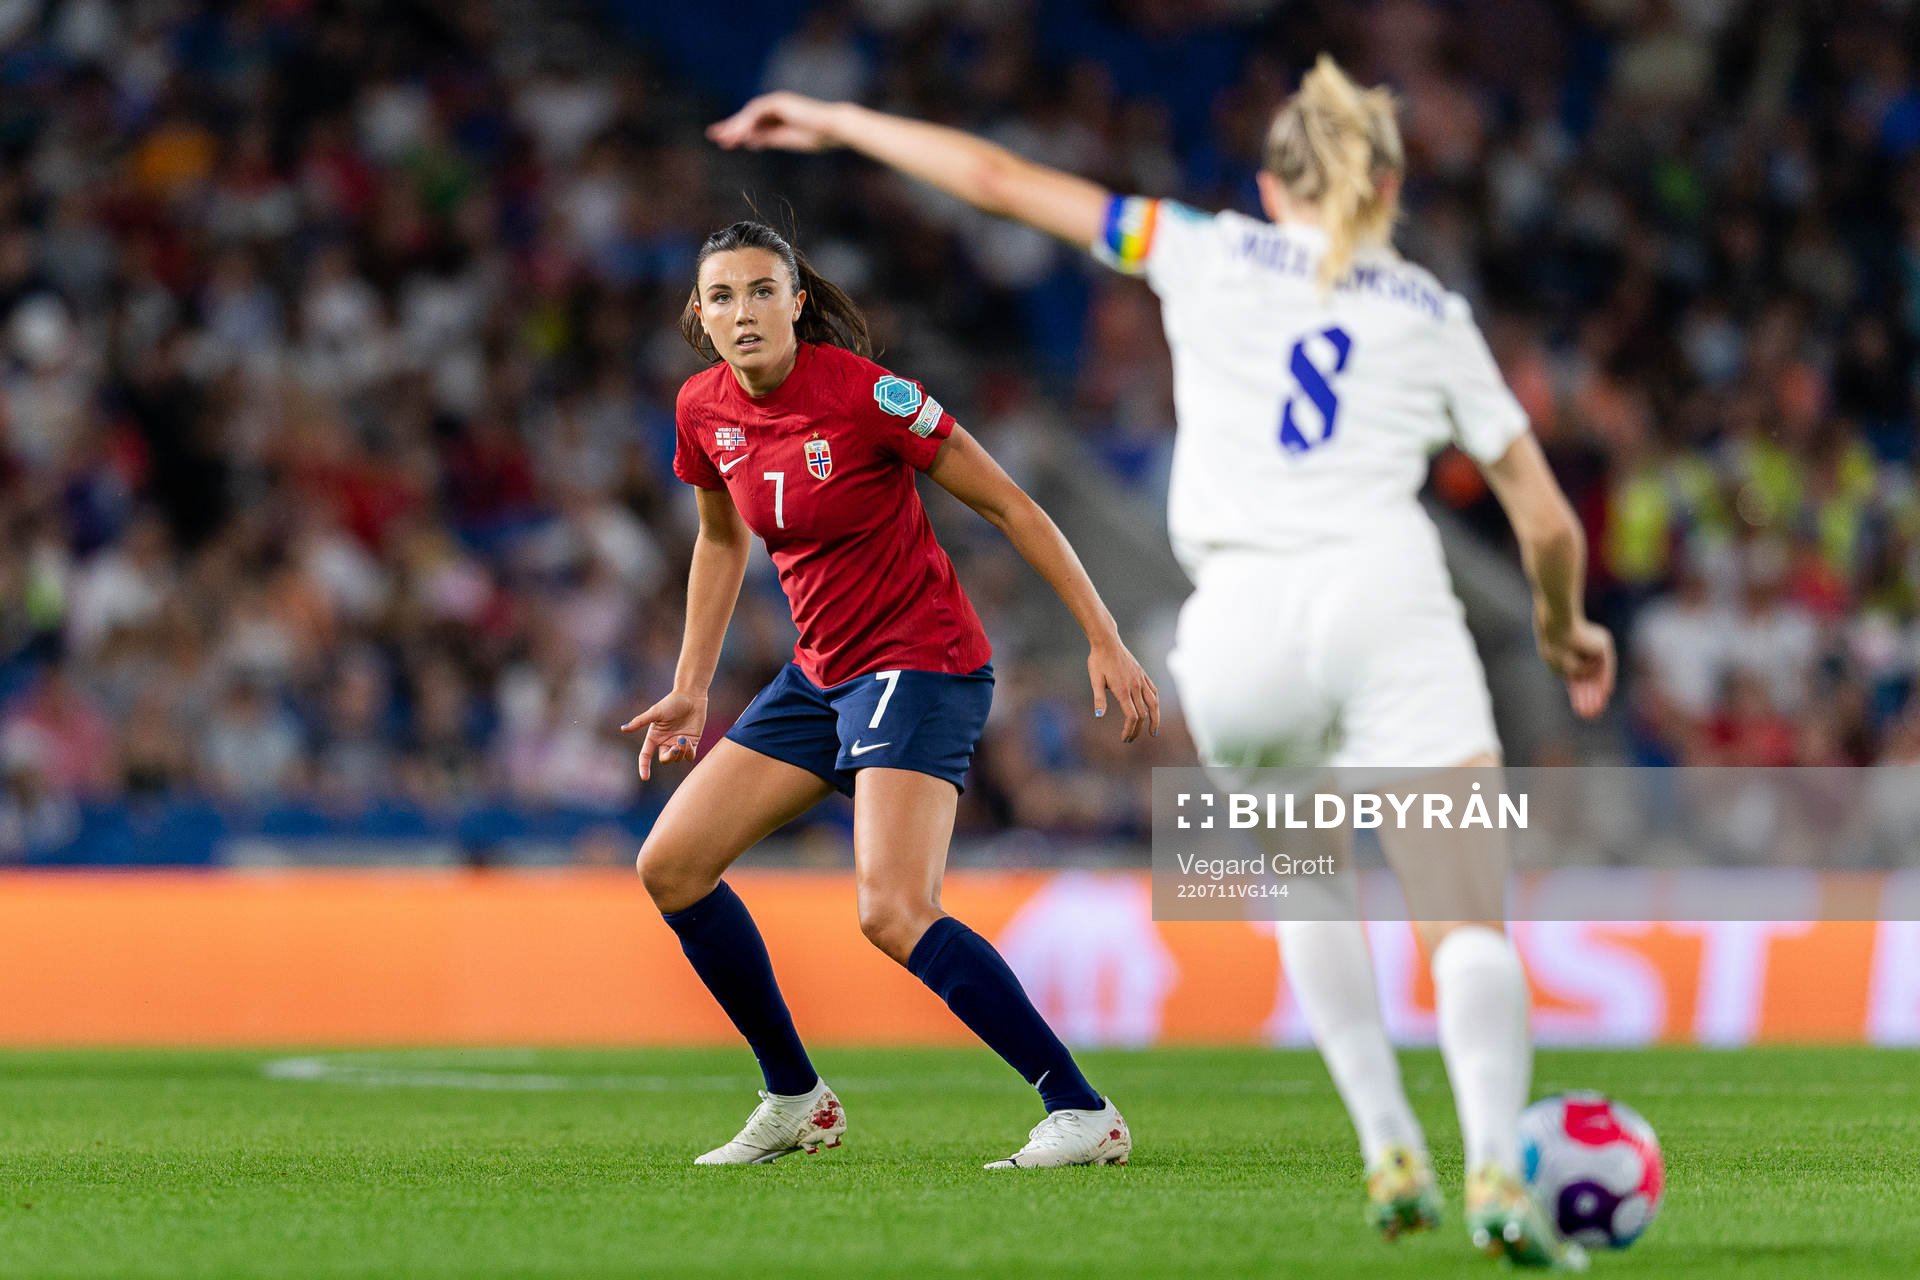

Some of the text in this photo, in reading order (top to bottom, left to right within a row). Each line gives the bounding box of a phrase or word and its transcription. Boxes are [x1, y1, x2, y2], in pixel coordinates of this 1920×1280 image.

[1279, 325, 1353, 453] 8
[763, 471, 785, 529] 7
[868, 669, 902, 729] 7
